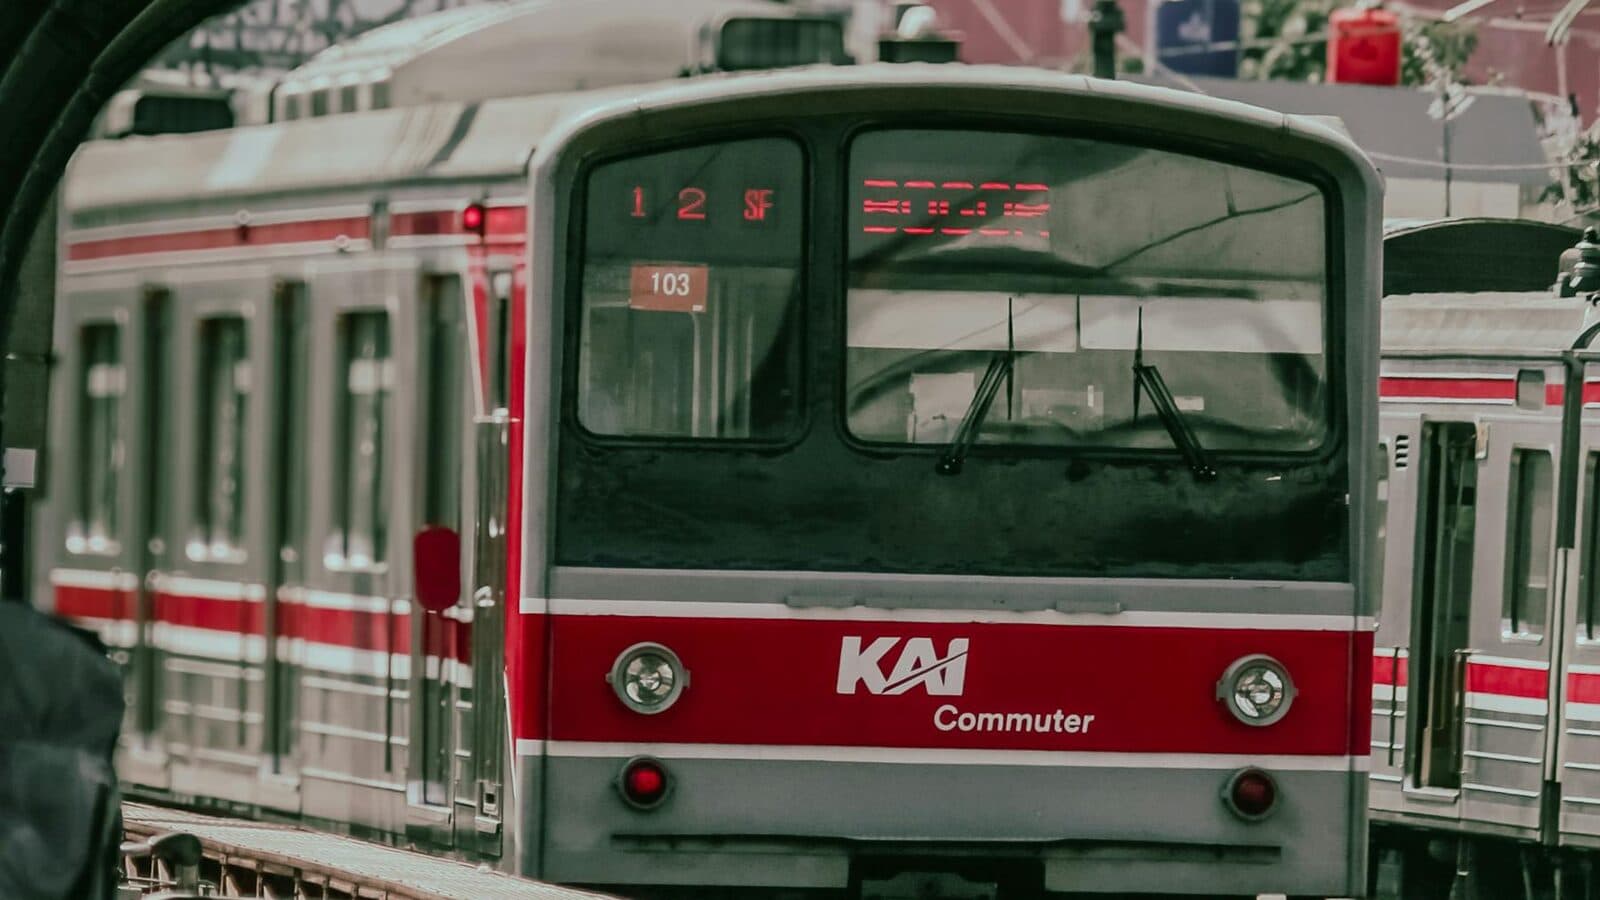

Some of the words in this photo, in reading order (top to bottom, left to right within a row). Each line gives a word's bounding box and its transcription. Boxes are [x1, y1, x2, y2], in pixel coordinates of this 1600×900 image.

[631, 186, 646, 217] 1
[677, 187, 706, 220] 2
[651, 272, 690, 296] 103
[836, 636, 970, 696] KAI
[933, 704, 1095, 734] Commuter
